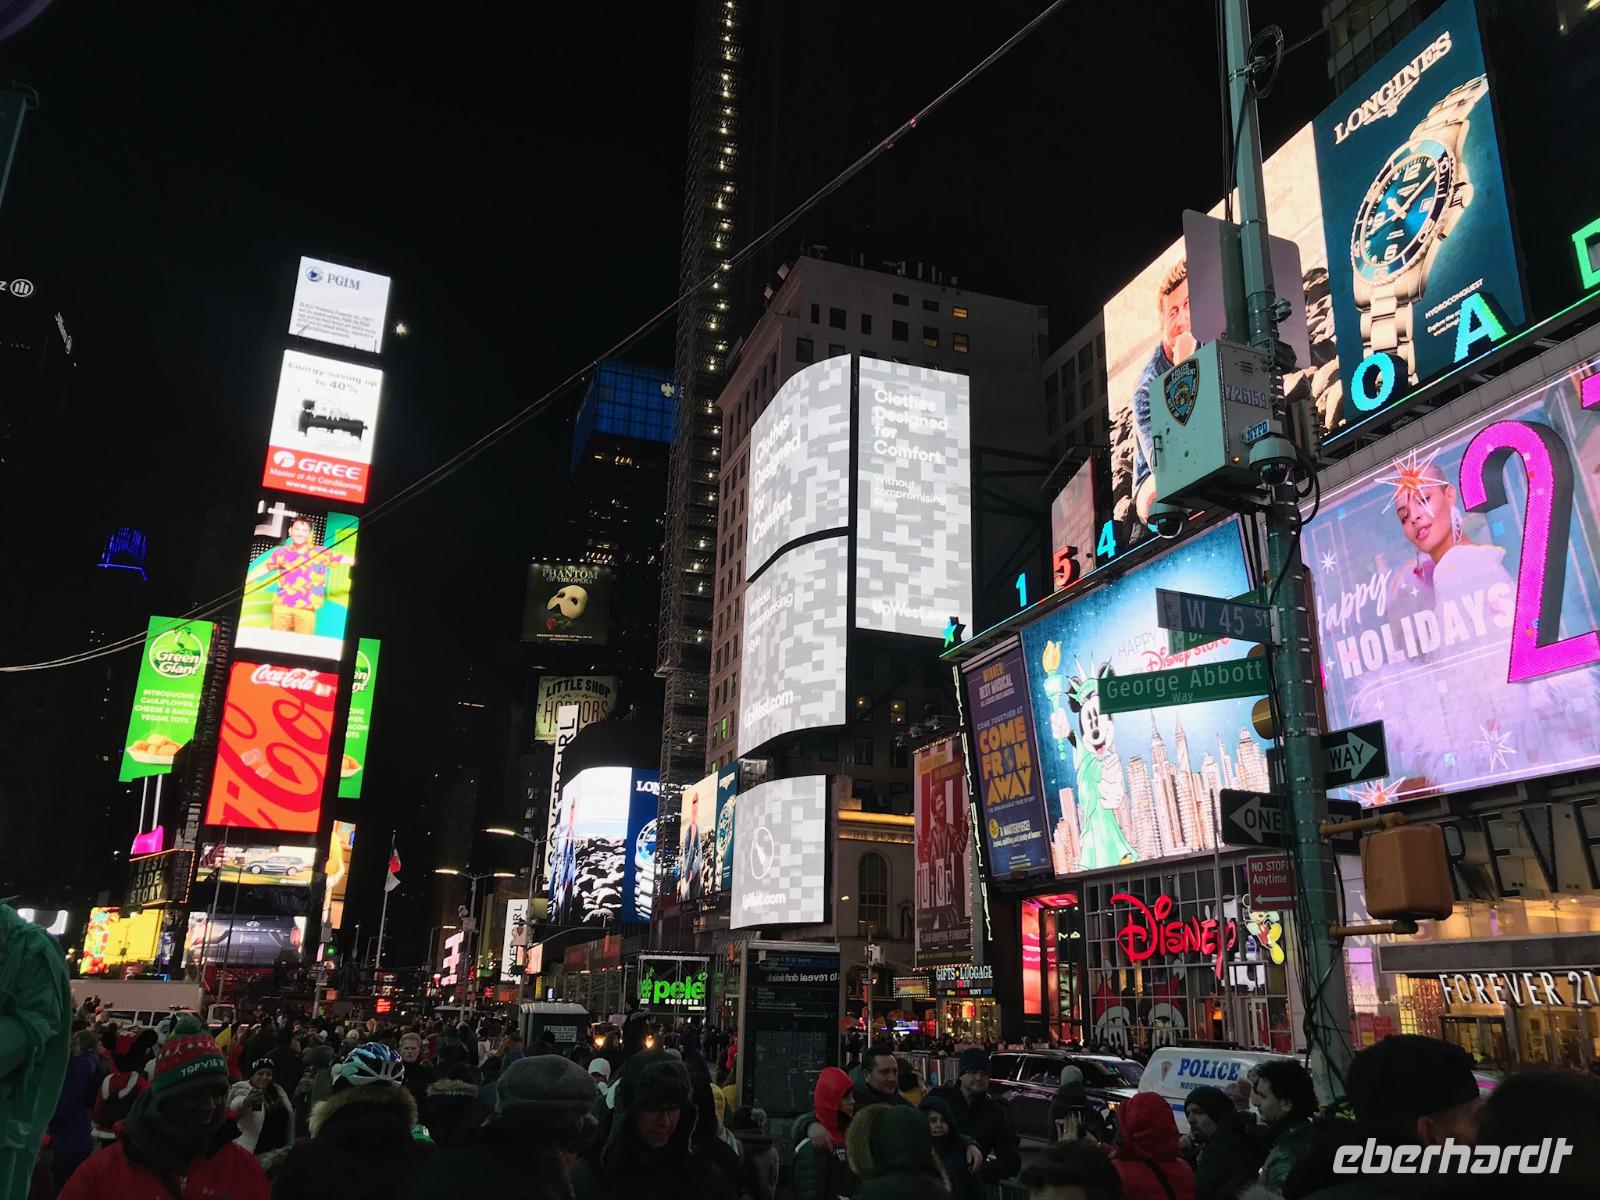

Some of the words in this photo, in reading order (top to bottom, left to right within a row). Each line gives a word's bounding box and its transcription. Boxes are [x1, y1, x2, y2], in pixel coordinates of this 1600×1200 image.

[1334, 31, 1452, 144] LONGINES
[327, 273, 360, 290] PGIM
[875, 388, 936, 412] Clothes
[874, 406, 948, 431] Designed
[873, 422, 898, 438] for
[1247, 420, 1269, 442] NYPD
[873, 440, 943, 464] Comfort
[270, 467, 295, 479] Master
[306, 474, 316, 482] Air
[318, 475, 363, 491] Conditioning
[298, 458, 362, 480] GREE
[286, 481, 346, 496] www.gree.com
[542, 568, 598, 579] PHANTOM
[1187, 601, 1206, 629] W
[1220, 605, 1245, 635] 45
[1255, 609, 1271, 628] St
[1337, 581, 1516, 680] HOLIDAYS
[1118, 629, 1158, 658] HAPPY
[155, 651, 200, 664] Green
[158, 661, 199, 675] Giant
[546, 679, 583, 698] LITTLE
[585, 680, 611, 698] SHOP
[1106, 673, 1178, 700] George
[1190, 661, 1263, 689] Abbott
[1172, 690, 1194, 704] Way
[979, 715, 1026, 753] COME
[982, 741, 1031, 780] FROM
[1328, 743, 1365, 770] WAY
[987, 768, 1032, 806] AWAY
[1245, 809, 1282, 831] ONE
[1251, 861, 1264, 873] NO
[136, 870, 161, 889] SIDE
[1253, 873, 1288, 887] Anytime
[131, 885, 162, 903] STORY
[936, 967, 956, 981] GIFTS
[960, 965, 993, 981] LUGGAGE
[1439, 971, 1566, 1007] FOREVER
[1568, 970, 1600, 1007] 21
[1178, 1058, 1241, 1081] POLICE
